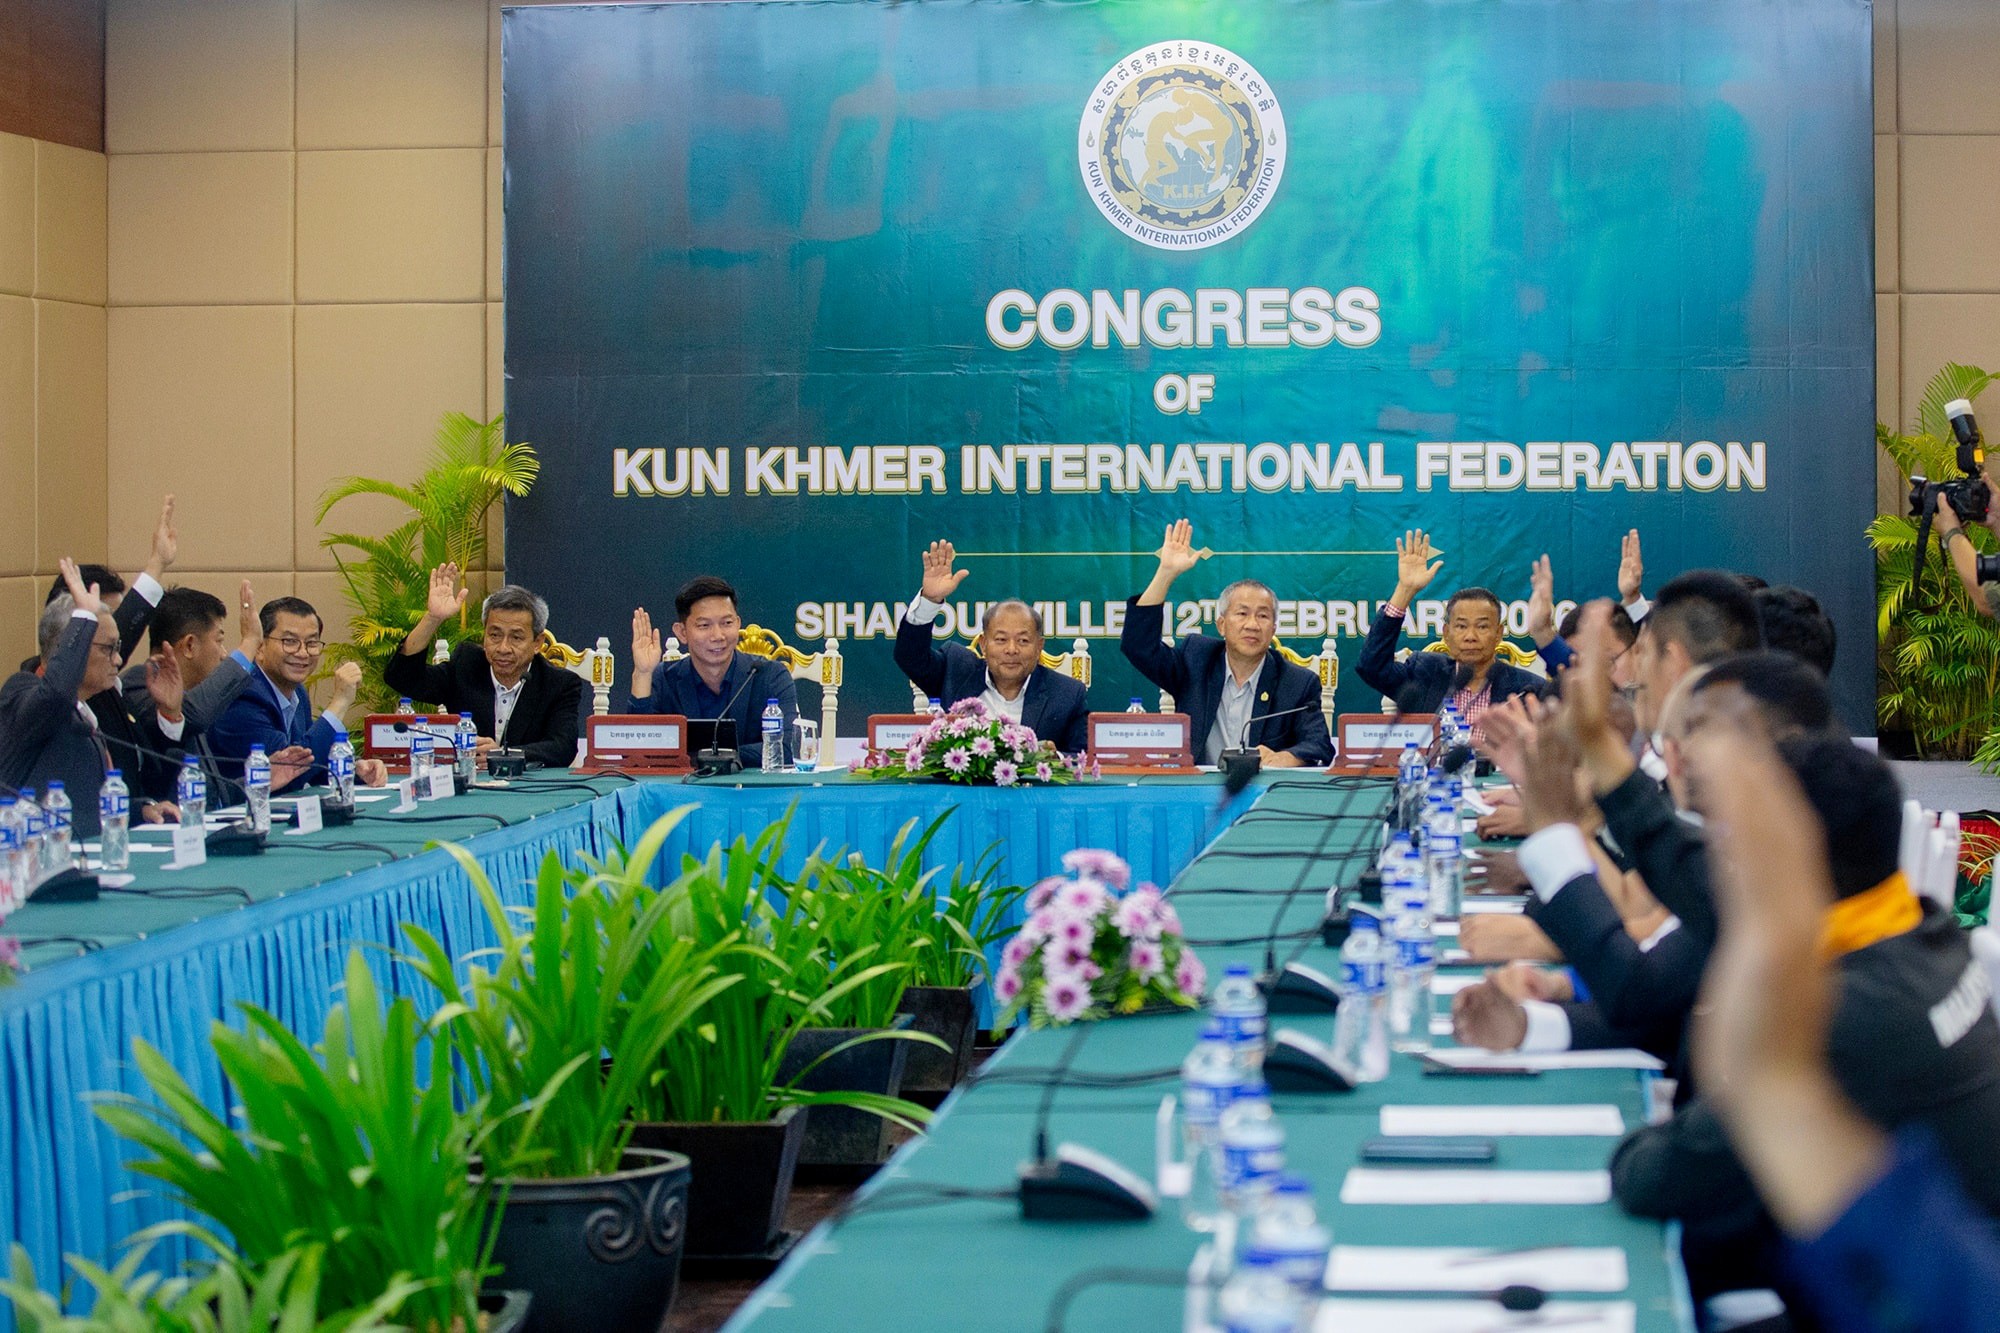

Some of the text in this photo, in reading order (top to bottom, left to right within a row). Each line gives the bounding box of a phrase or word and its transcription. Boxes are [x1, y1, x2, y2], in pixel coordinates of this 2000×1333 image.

[1087, 157, 1276, 245] KUN KHMER INTERNATIONAL FEDERATION
[986, 289, 1381, 349] CONGRESS
[1154, 374, 1214, 415] OF
[613, 441, 1766, 495] KUN KHMER INTERNATIONAL FEDERATION
